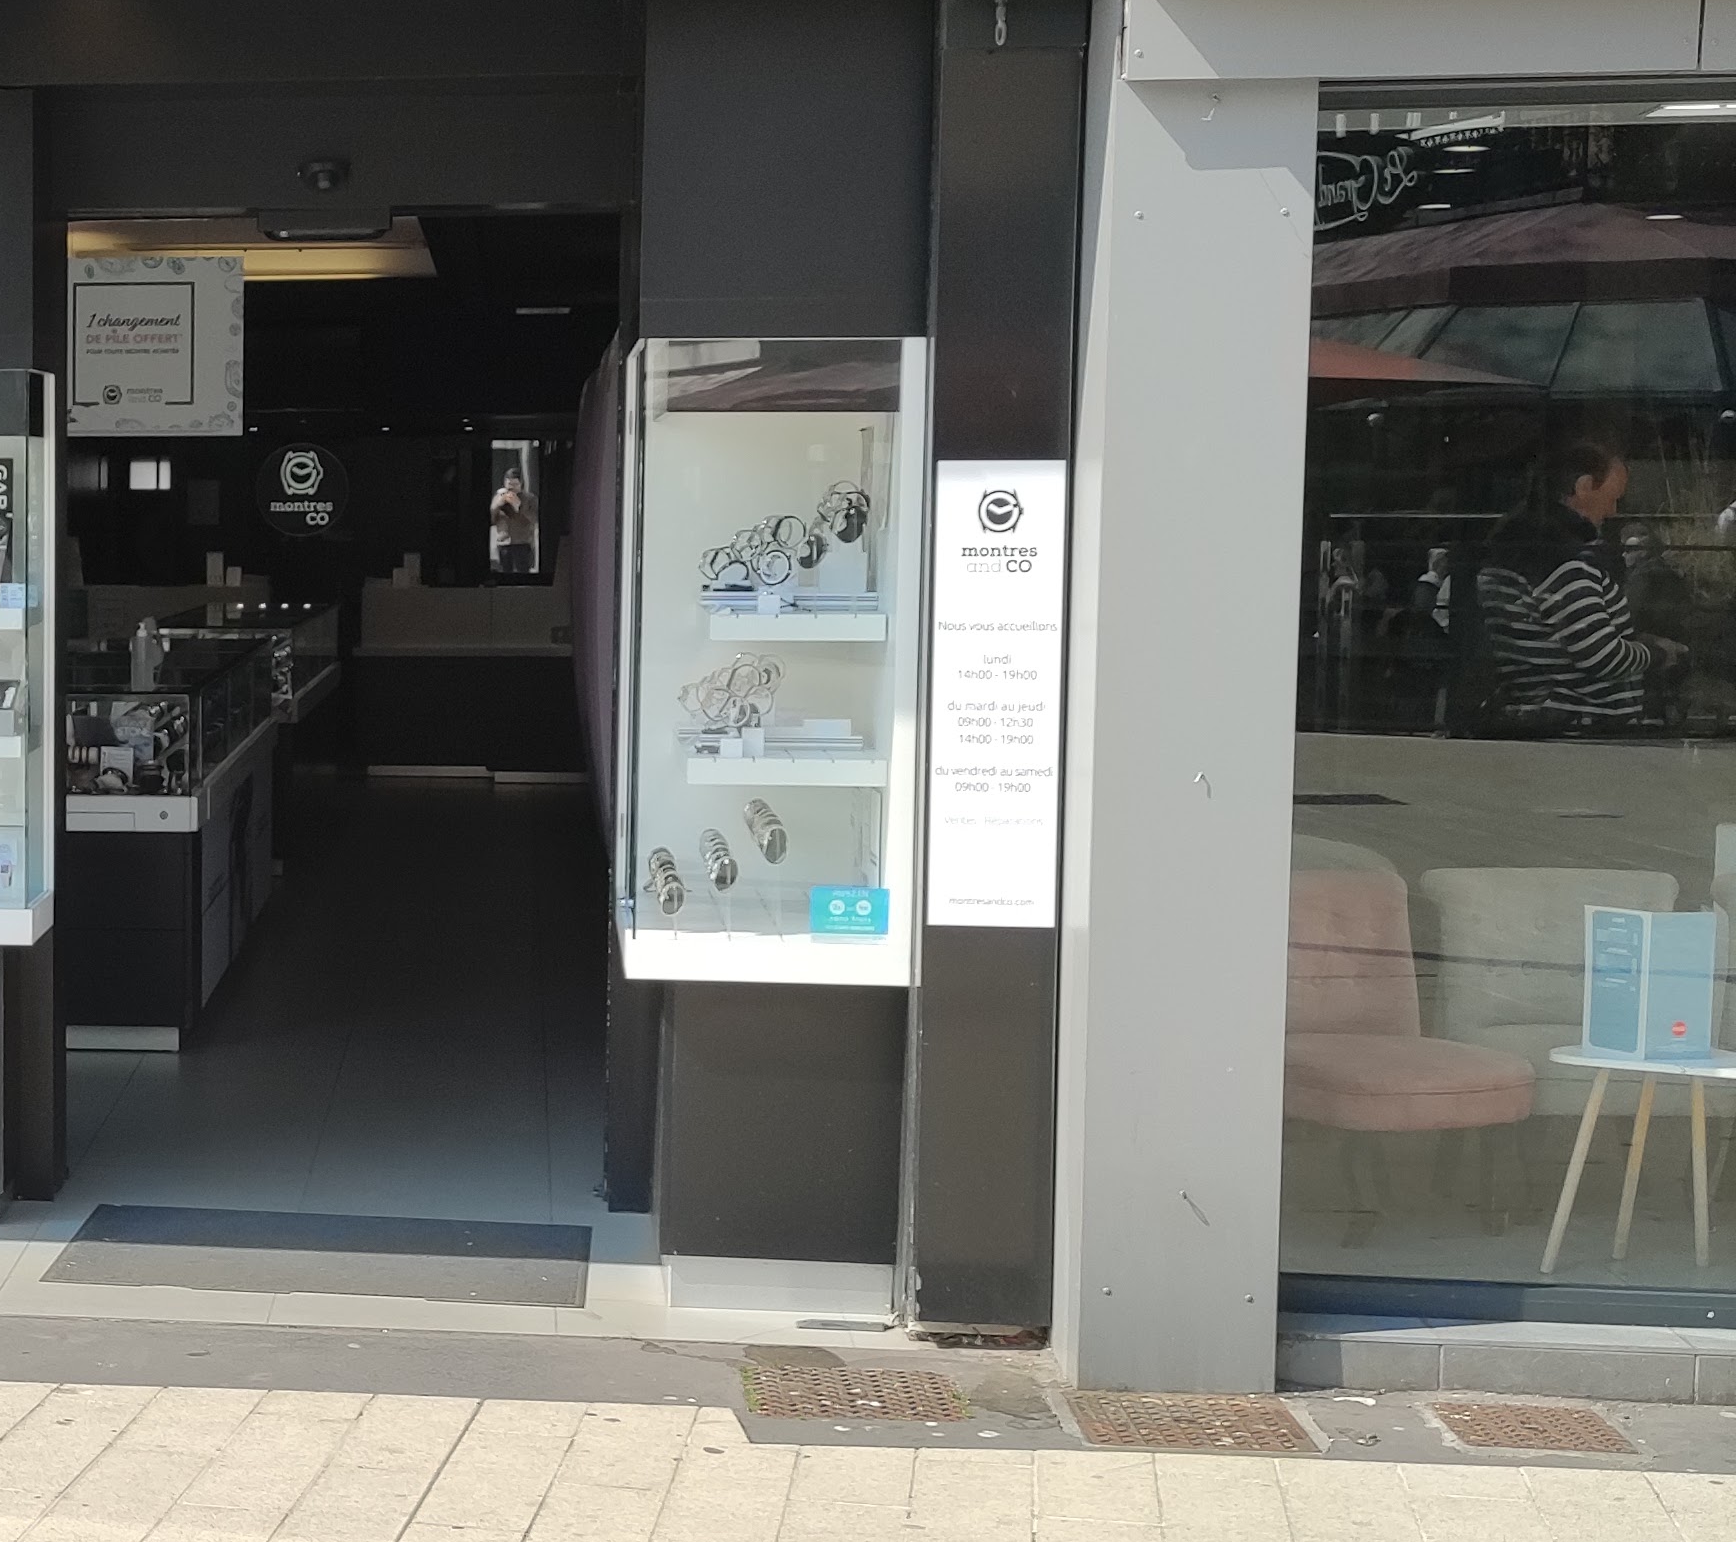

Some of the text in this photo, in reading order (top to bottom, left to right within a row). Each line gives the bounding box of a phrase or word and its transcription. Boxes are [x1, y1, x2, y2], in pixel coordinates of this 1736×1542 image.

[97, 313, 182, 331] changement
[85, 334, 101, 344] DE
[270, 500, 333, 512] montres
[305, 512, 329, 525] CO
[961, 545, 1038, 557] montres
[966, 559, 1032, 573] and CO
[938, 621, 1058, 631] Nous vous accueillons
[983, 654, 1012, 665] lundi
[958, 670, 992, 679] 14h00
[1003, 670, 1037, 680] 19h00
[947, 700, 1045, 713] du mardi au jeudi
[957, 717, 992, 727] 09h00
[1000, 717, 1034, 727] 12h30
[959, 734, 992, 744] 14h00
[1000, 734, 1034, 744] 19h00
[935, 765, 949, 776] du
[1000, 768, 1012, 776] au
[955, 782, 989, 792] 09h00
[998, 782, 1031, 793] 19h00
